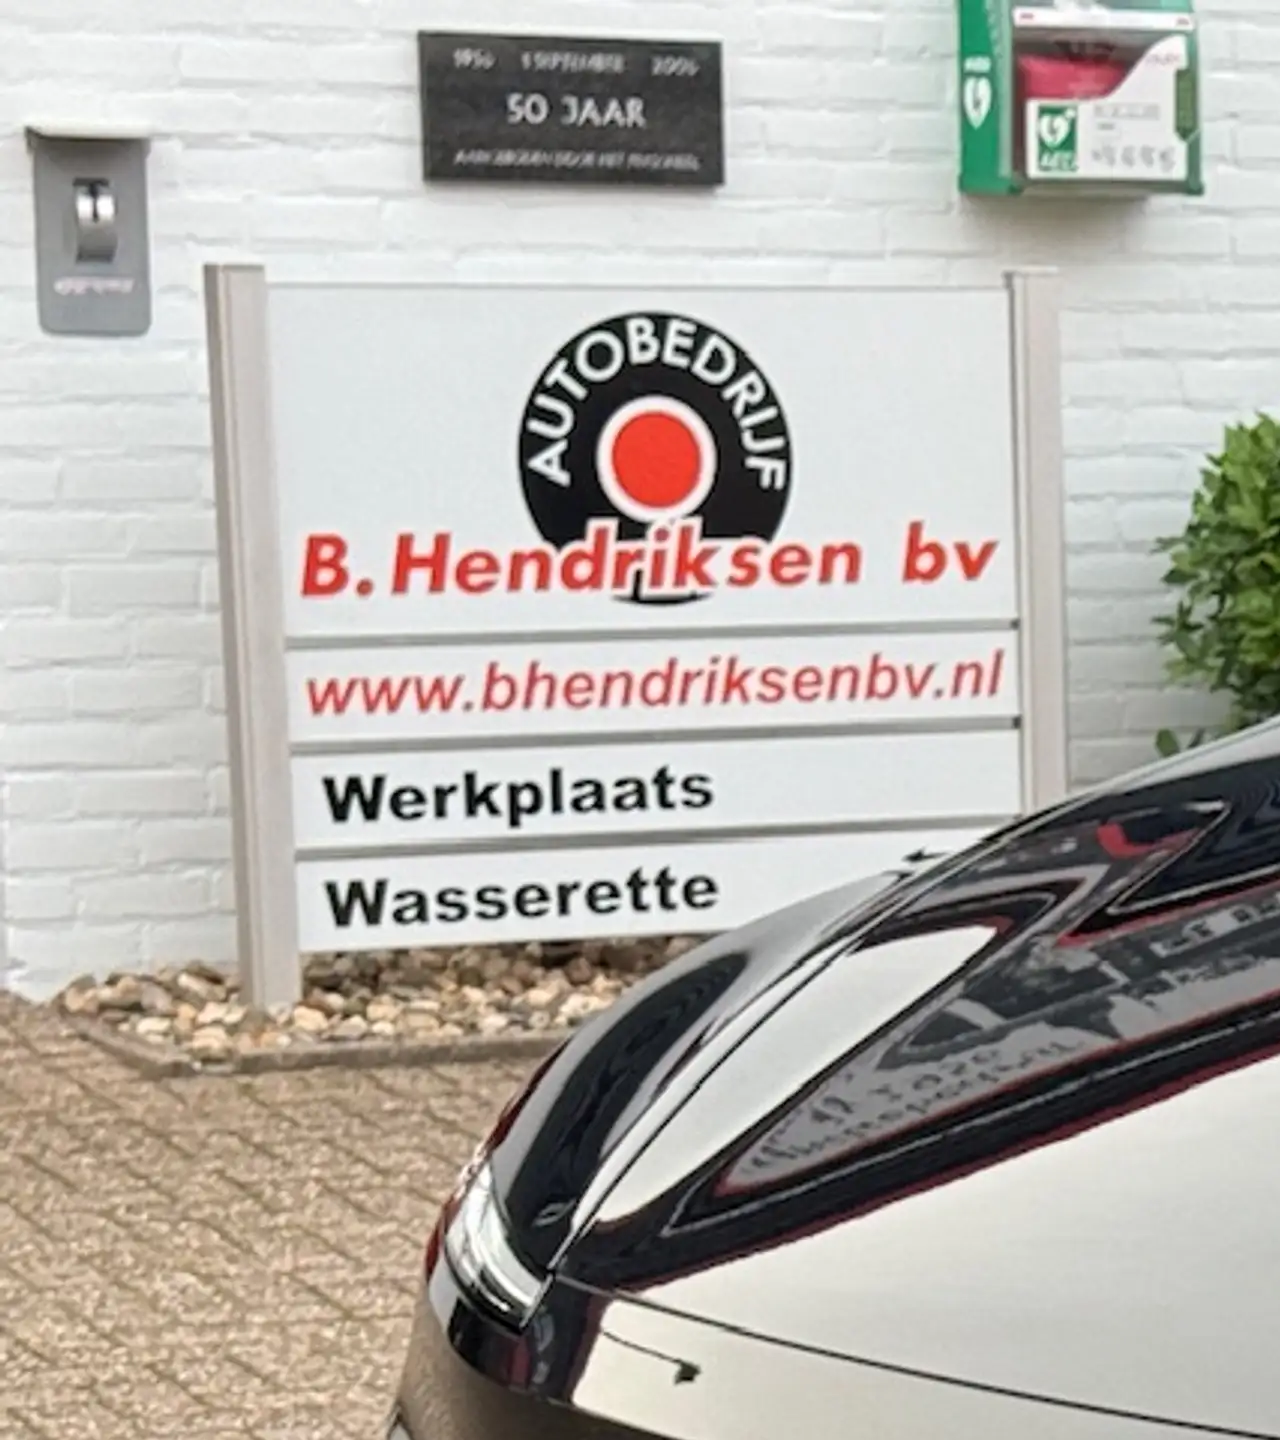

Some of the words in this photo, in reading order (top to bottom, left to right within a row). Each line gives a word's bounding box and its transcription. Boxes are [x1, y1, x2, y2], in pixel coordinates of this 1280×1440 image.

[506, 92, 549, 125] 50
[560, 95, 647, 128] JAAR
[527, 316, 787, 492] AUTOBEDRIJF
[903, 521, 999, 582] bv
[305, 650, 1005, 716] www.bhendriksenbv.nl
[322, 765, 715, 828] Werkplaats
[324, 867, 720, 928] Wasserette
